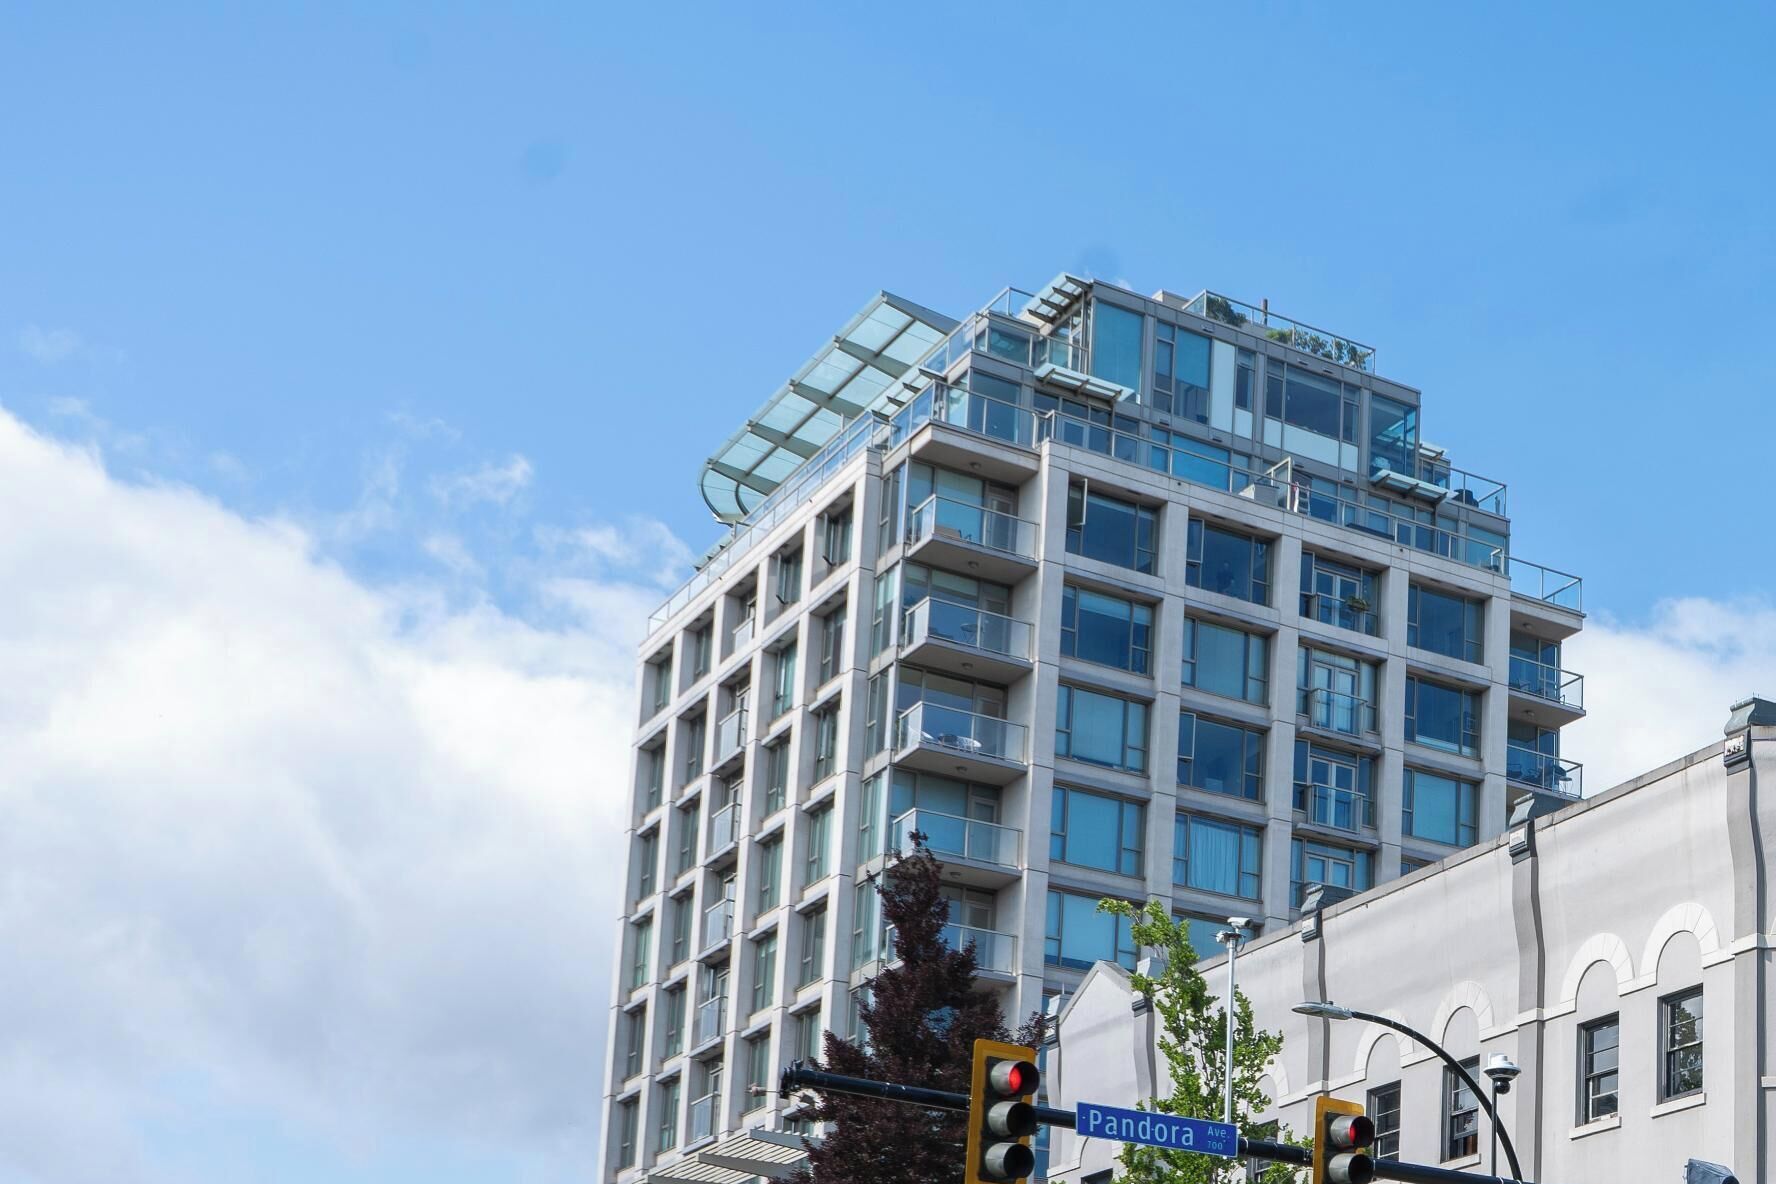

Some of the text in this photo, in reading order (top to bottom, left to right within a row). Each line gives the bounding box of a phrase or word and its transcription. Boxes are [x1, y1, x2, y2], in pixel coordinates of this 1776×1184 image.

[1089, 1109, 1230, 1147] Pandora Ave.
[1207, 1140, 1223, 1151] 700
